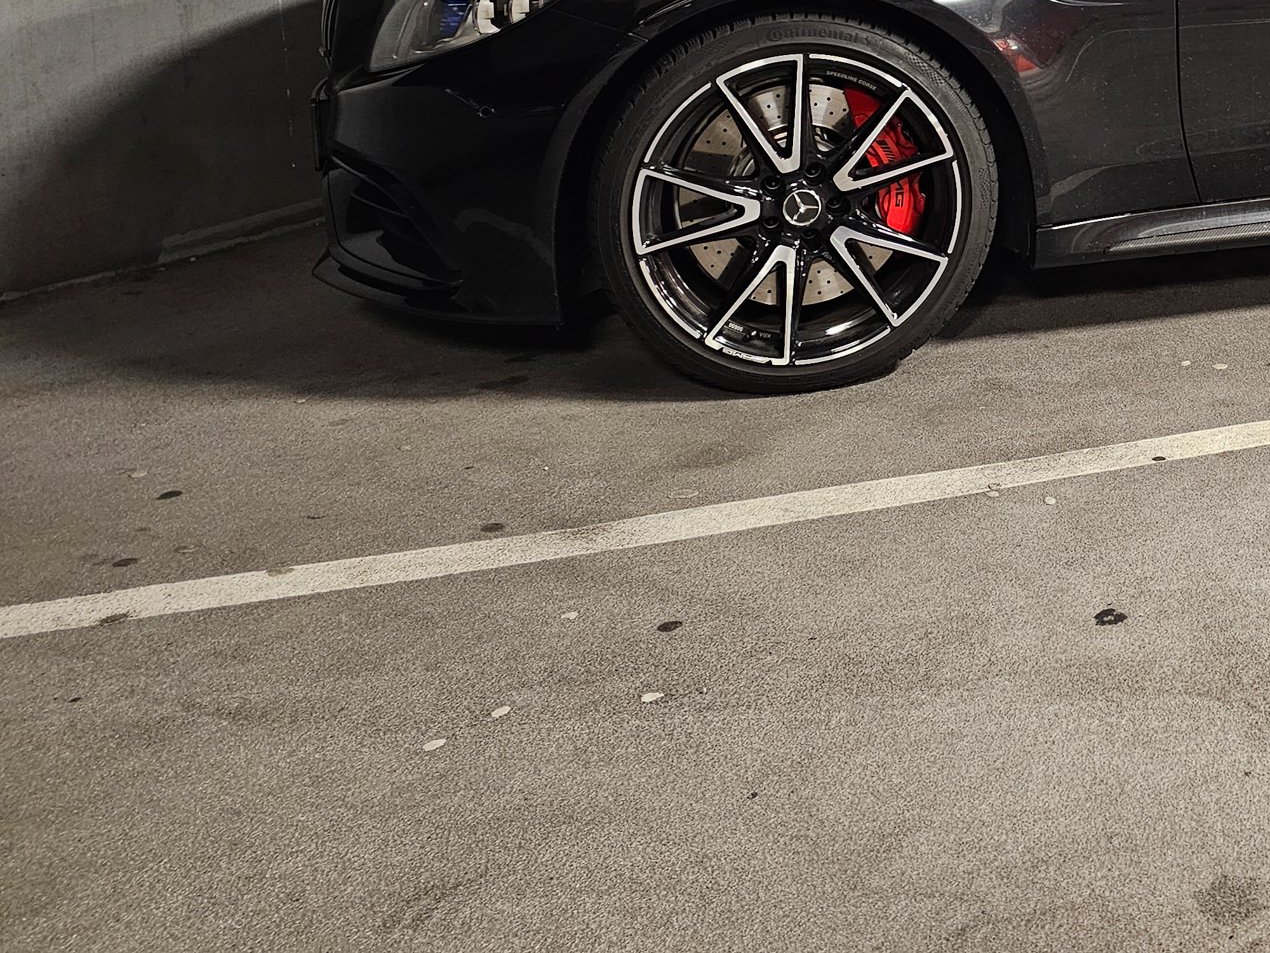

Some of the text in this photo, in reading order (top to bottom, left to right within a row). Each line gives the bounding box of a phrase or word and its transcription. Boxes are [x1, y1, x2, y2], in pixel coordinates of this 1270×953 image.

[765, 28, 860, 44] Continental
[826, 70, 877, 91] SPEEDLINE CORSE
[895, 180, 904, 208] MG
